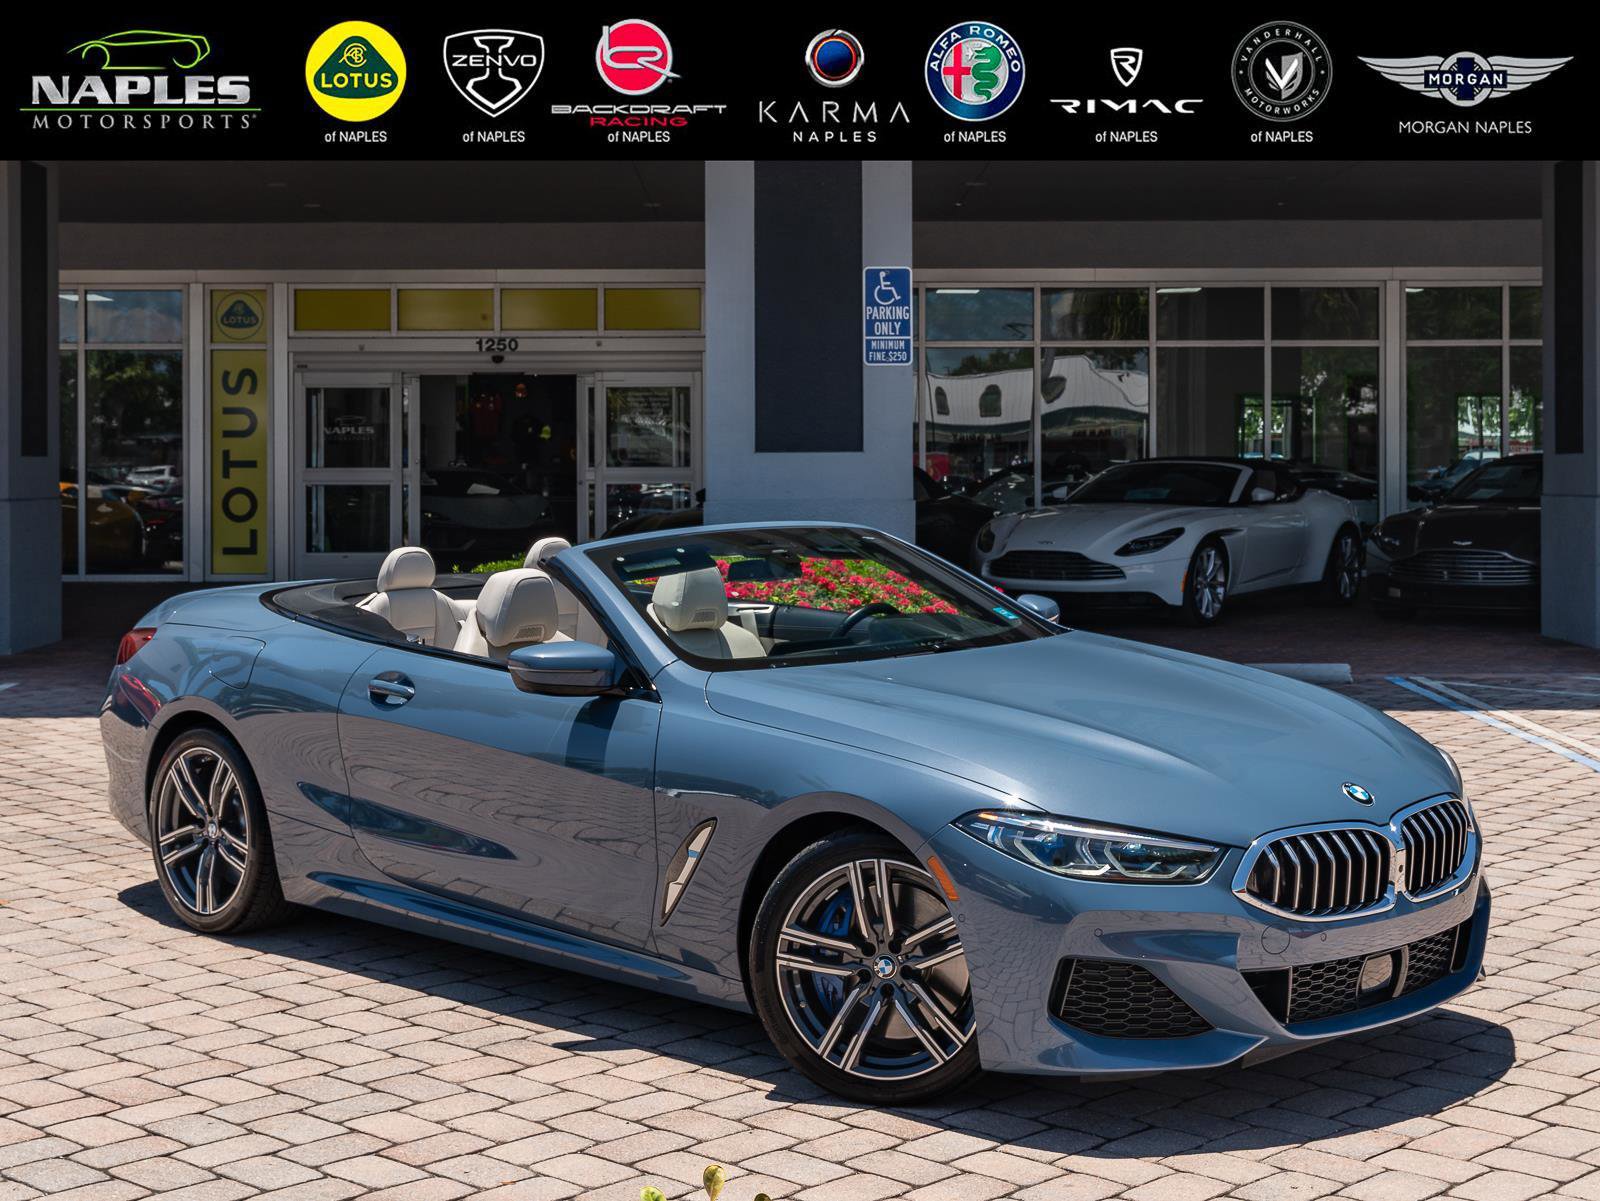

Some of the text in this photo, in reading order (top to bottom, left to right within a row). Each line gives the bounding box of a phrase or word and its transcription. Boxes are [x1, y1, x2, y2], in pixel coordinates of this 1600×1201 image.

[866, 306, 910, 320] PARKING
[874, 322, 901, 335] ONLY
[476, 337, 518, 352] 1250
[871, 340, 905, 350] MINIMUM
[869, 351, 907, 362] FINE $250
[222, 367, 258, 556] LOTUS
